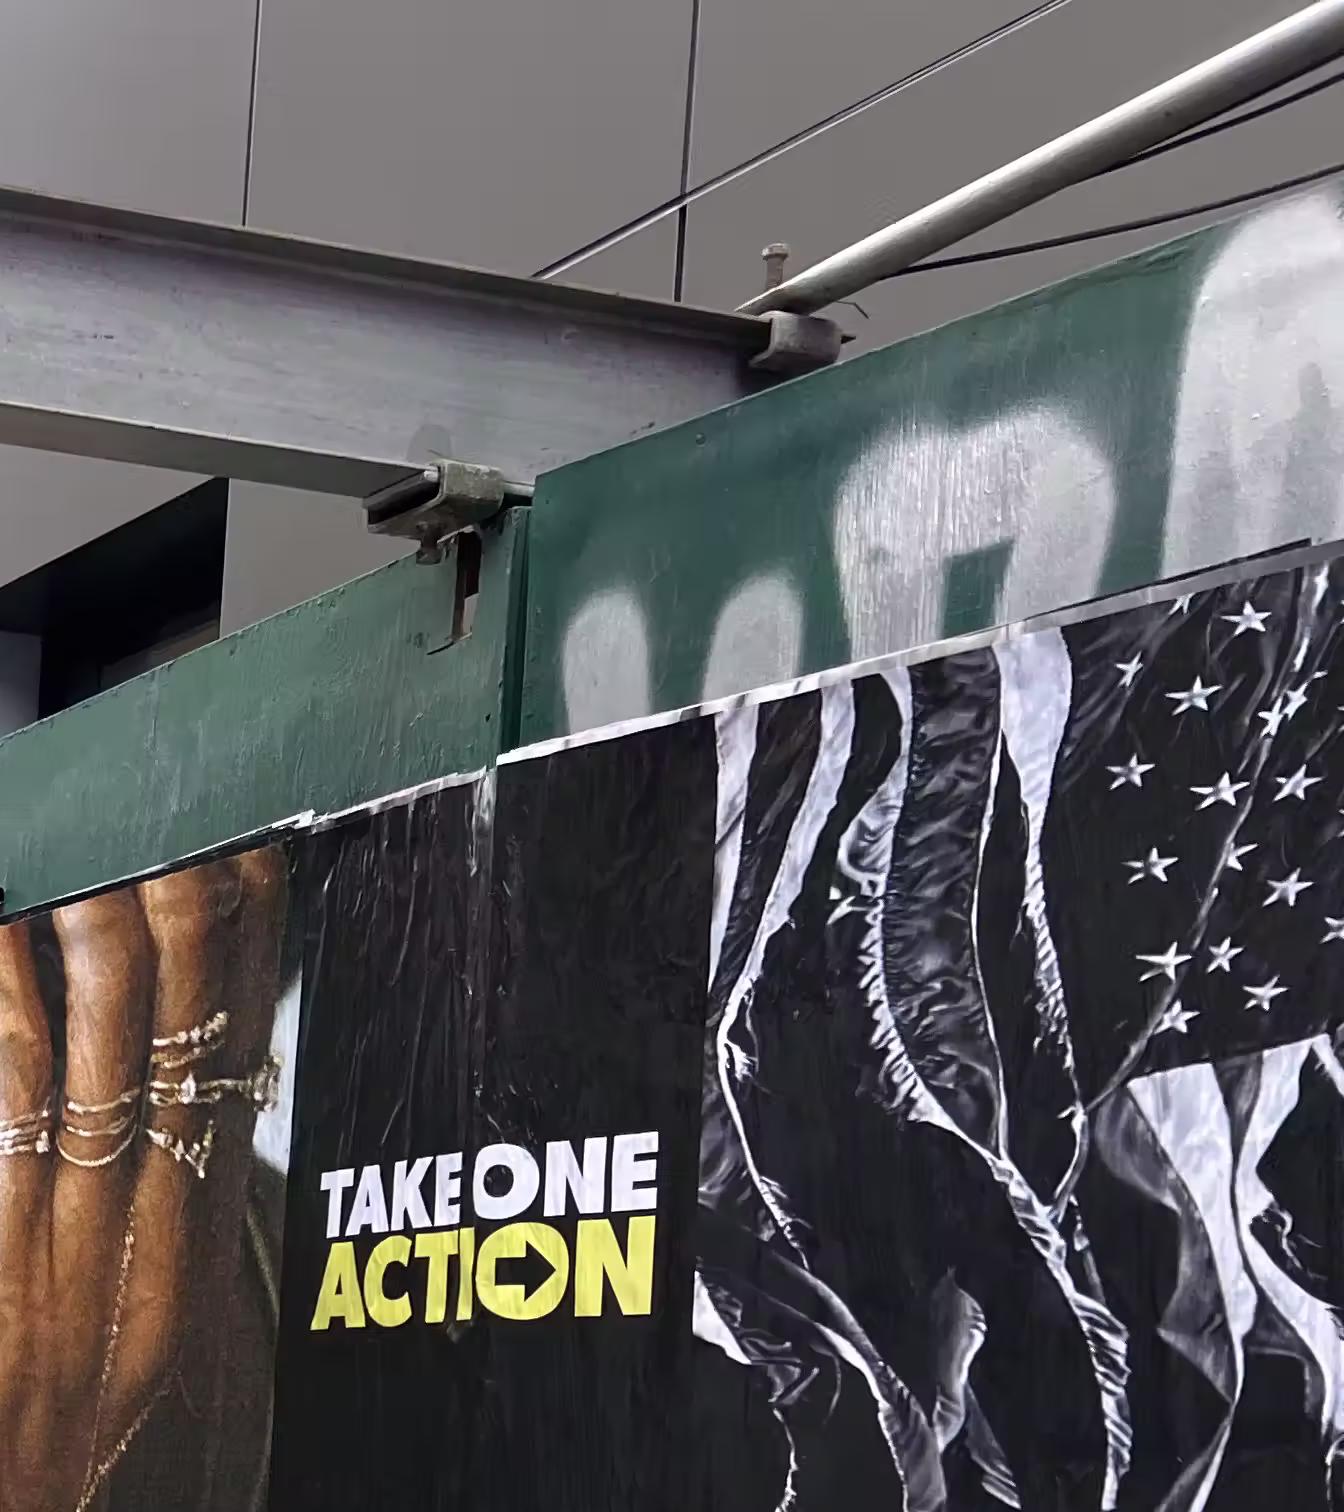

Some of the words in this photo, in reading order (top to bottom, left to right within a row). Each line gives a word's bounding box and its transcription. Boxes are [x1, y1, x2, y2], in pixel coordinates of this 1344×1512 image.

[320, 1152, 462, 1239] TAKE
[473, 1131, 659, 1219] ONE
[310, 1216, 657, 1330] ACTION
